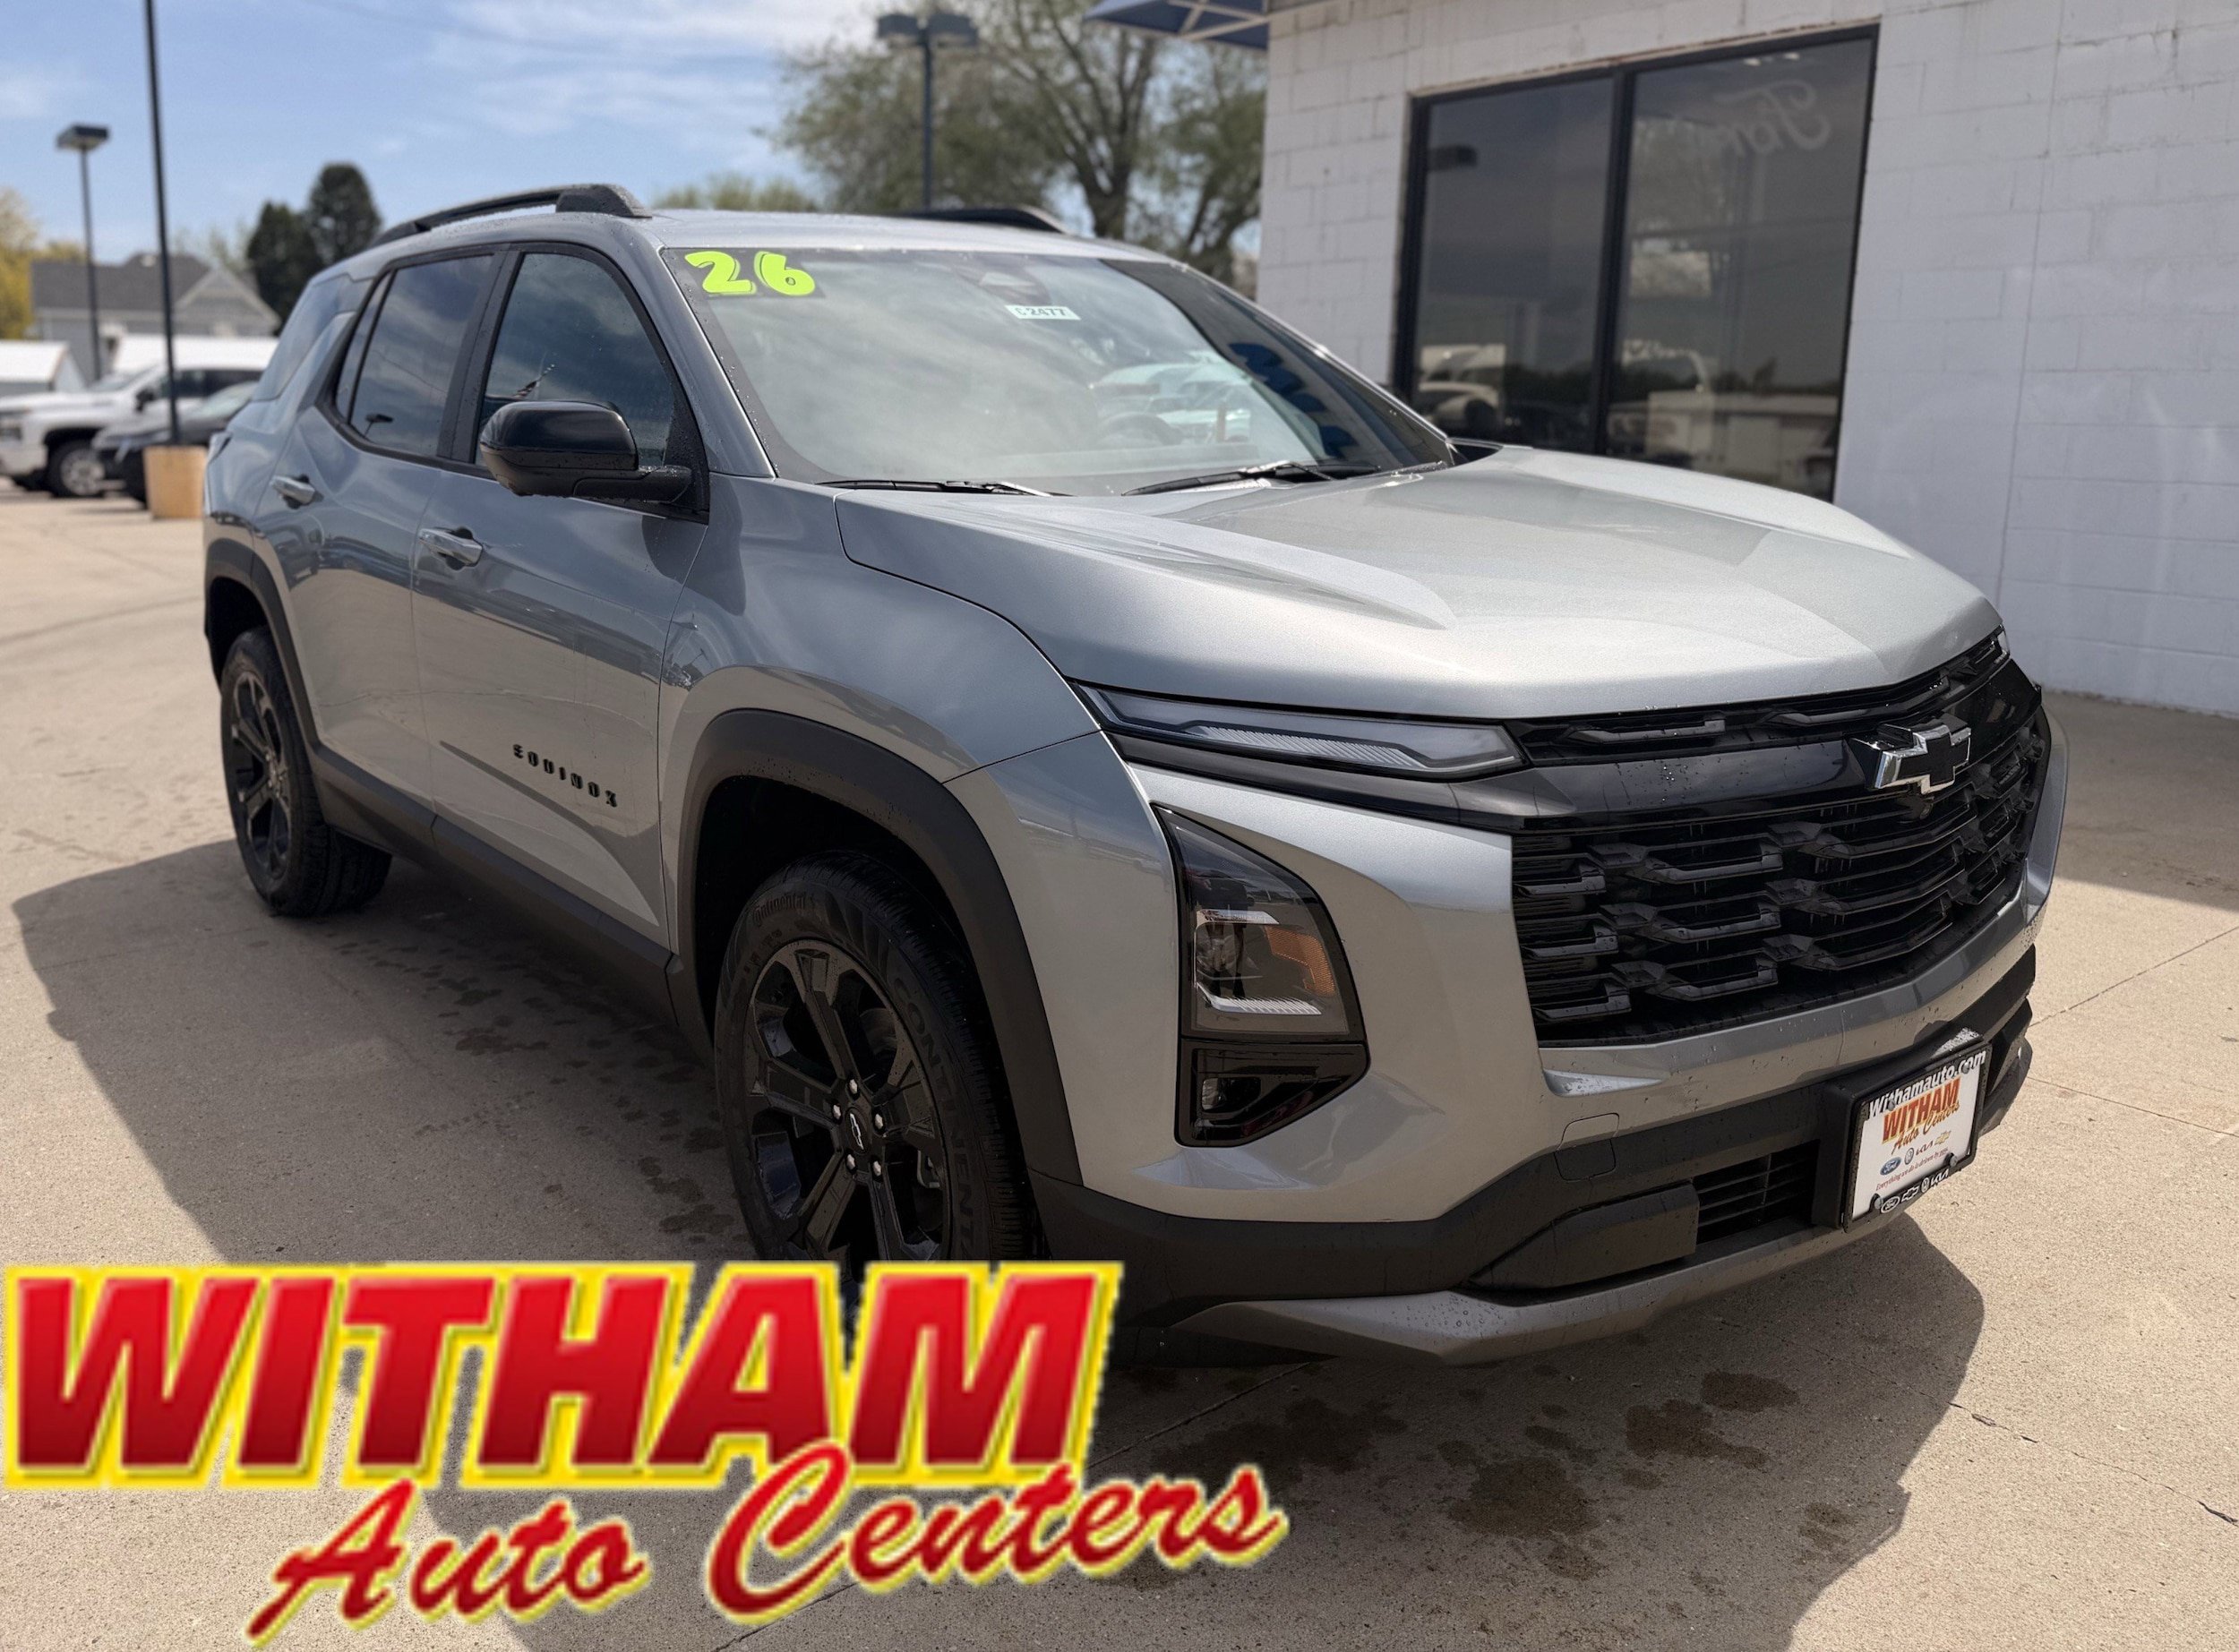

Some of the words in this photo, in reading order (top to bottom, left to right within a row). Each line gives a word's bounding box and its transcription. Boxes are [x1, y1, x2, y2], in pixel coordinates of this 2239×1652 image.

[684, 250, 816, 296] 26
[1883, 1076, 1960, 1143] WITHAM
[1891, 1127, 1919, 1154] Auto
[1923, 1100, 1960, 1134] Centers
